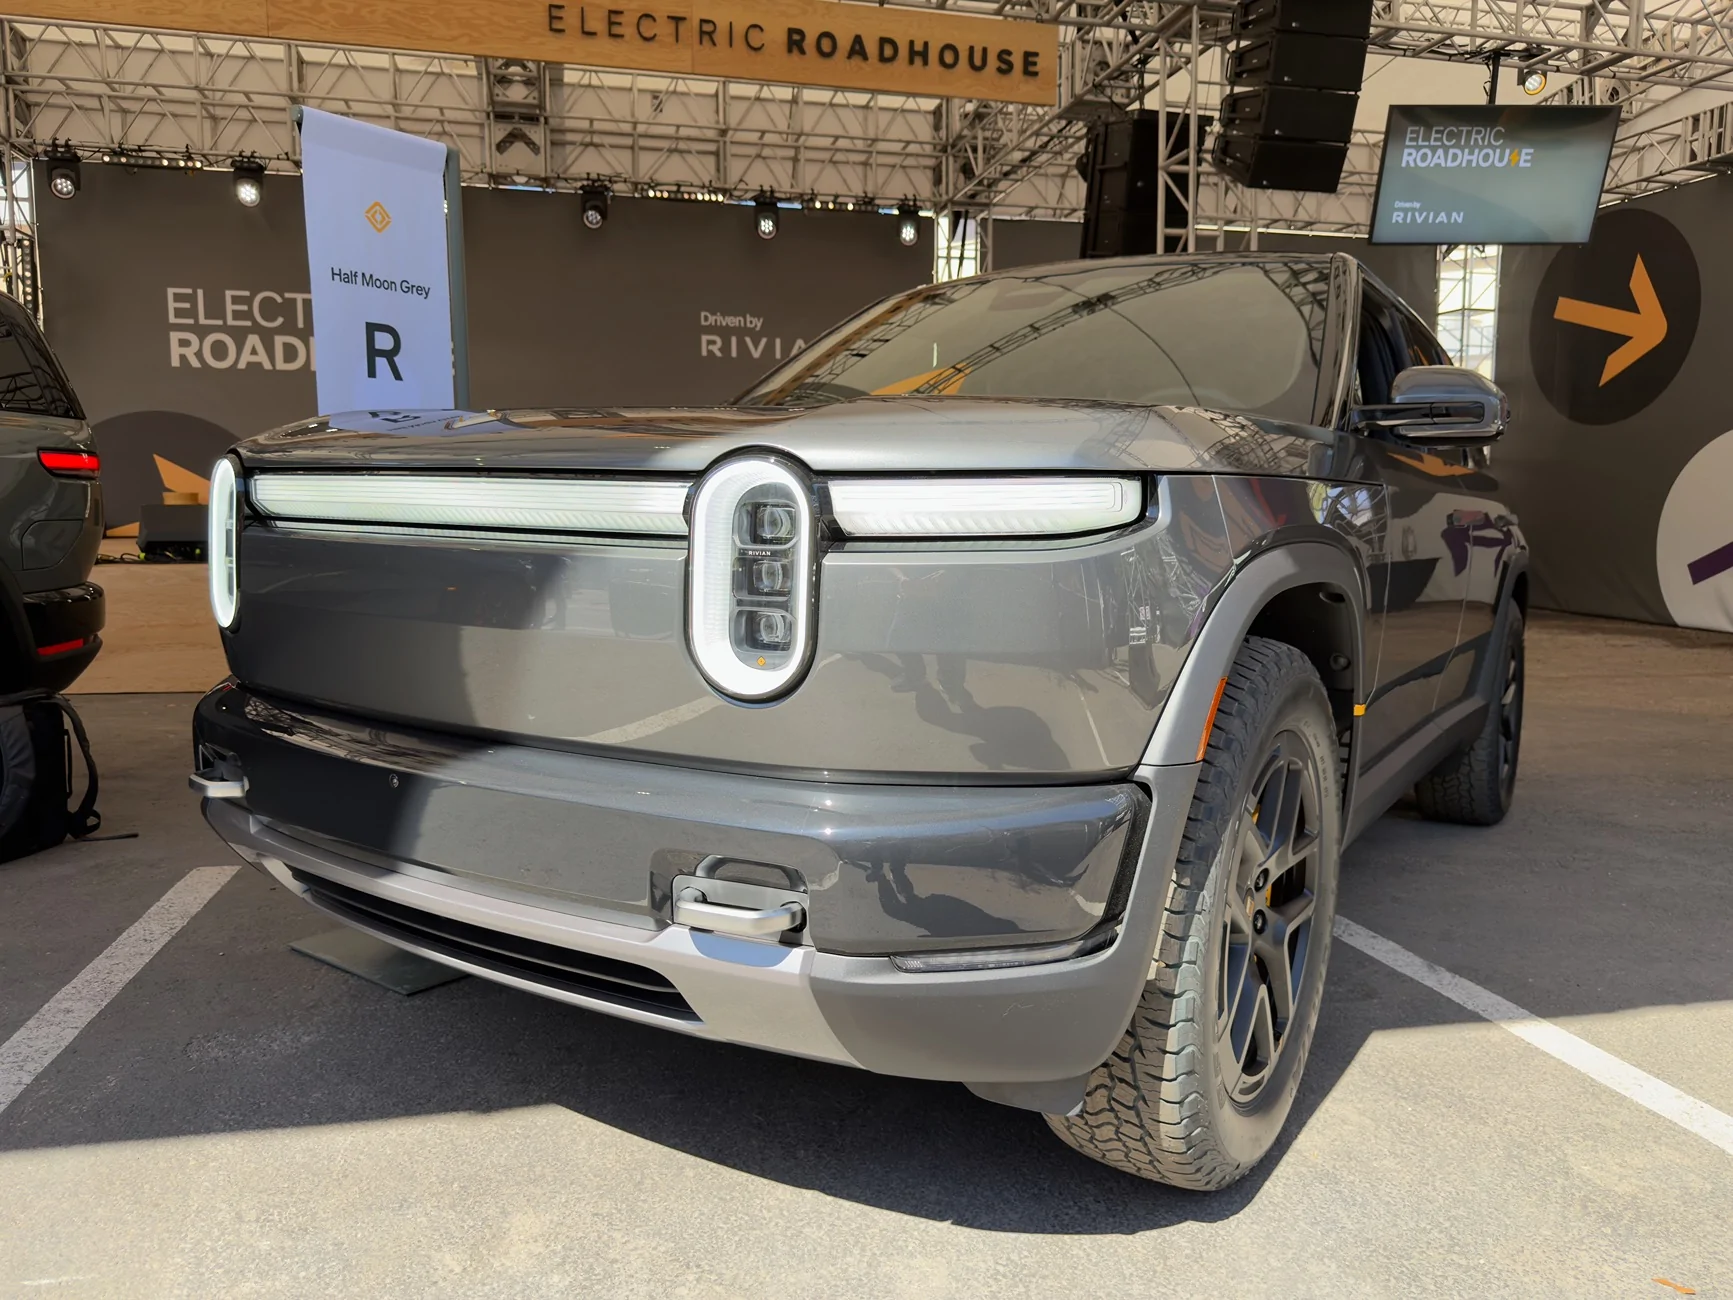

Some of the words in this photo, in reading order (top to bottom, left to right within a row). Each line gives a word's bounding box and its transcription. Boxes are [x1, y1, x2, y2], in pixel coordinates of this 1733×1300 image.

[547, 3, 766, 52] ELECTRIC
[786, 27, 1040, 77] ROADHOUSE
[1405, 126, 1506, 146] ELECTRIC
[1391, 211, 1464, 223] RIVIAN
[331, 267, 358, 285] Half
[361, 272, 397, 292] Moon
[400, 279, 431, 300] Grey
[166, 287, 313, 329] ELECT
[700, 311, 745, 328] Driven
[746, 313, 763, 331] by
[169, 331, 316, 371] ROAD
[365, 321, 403, 381] R
